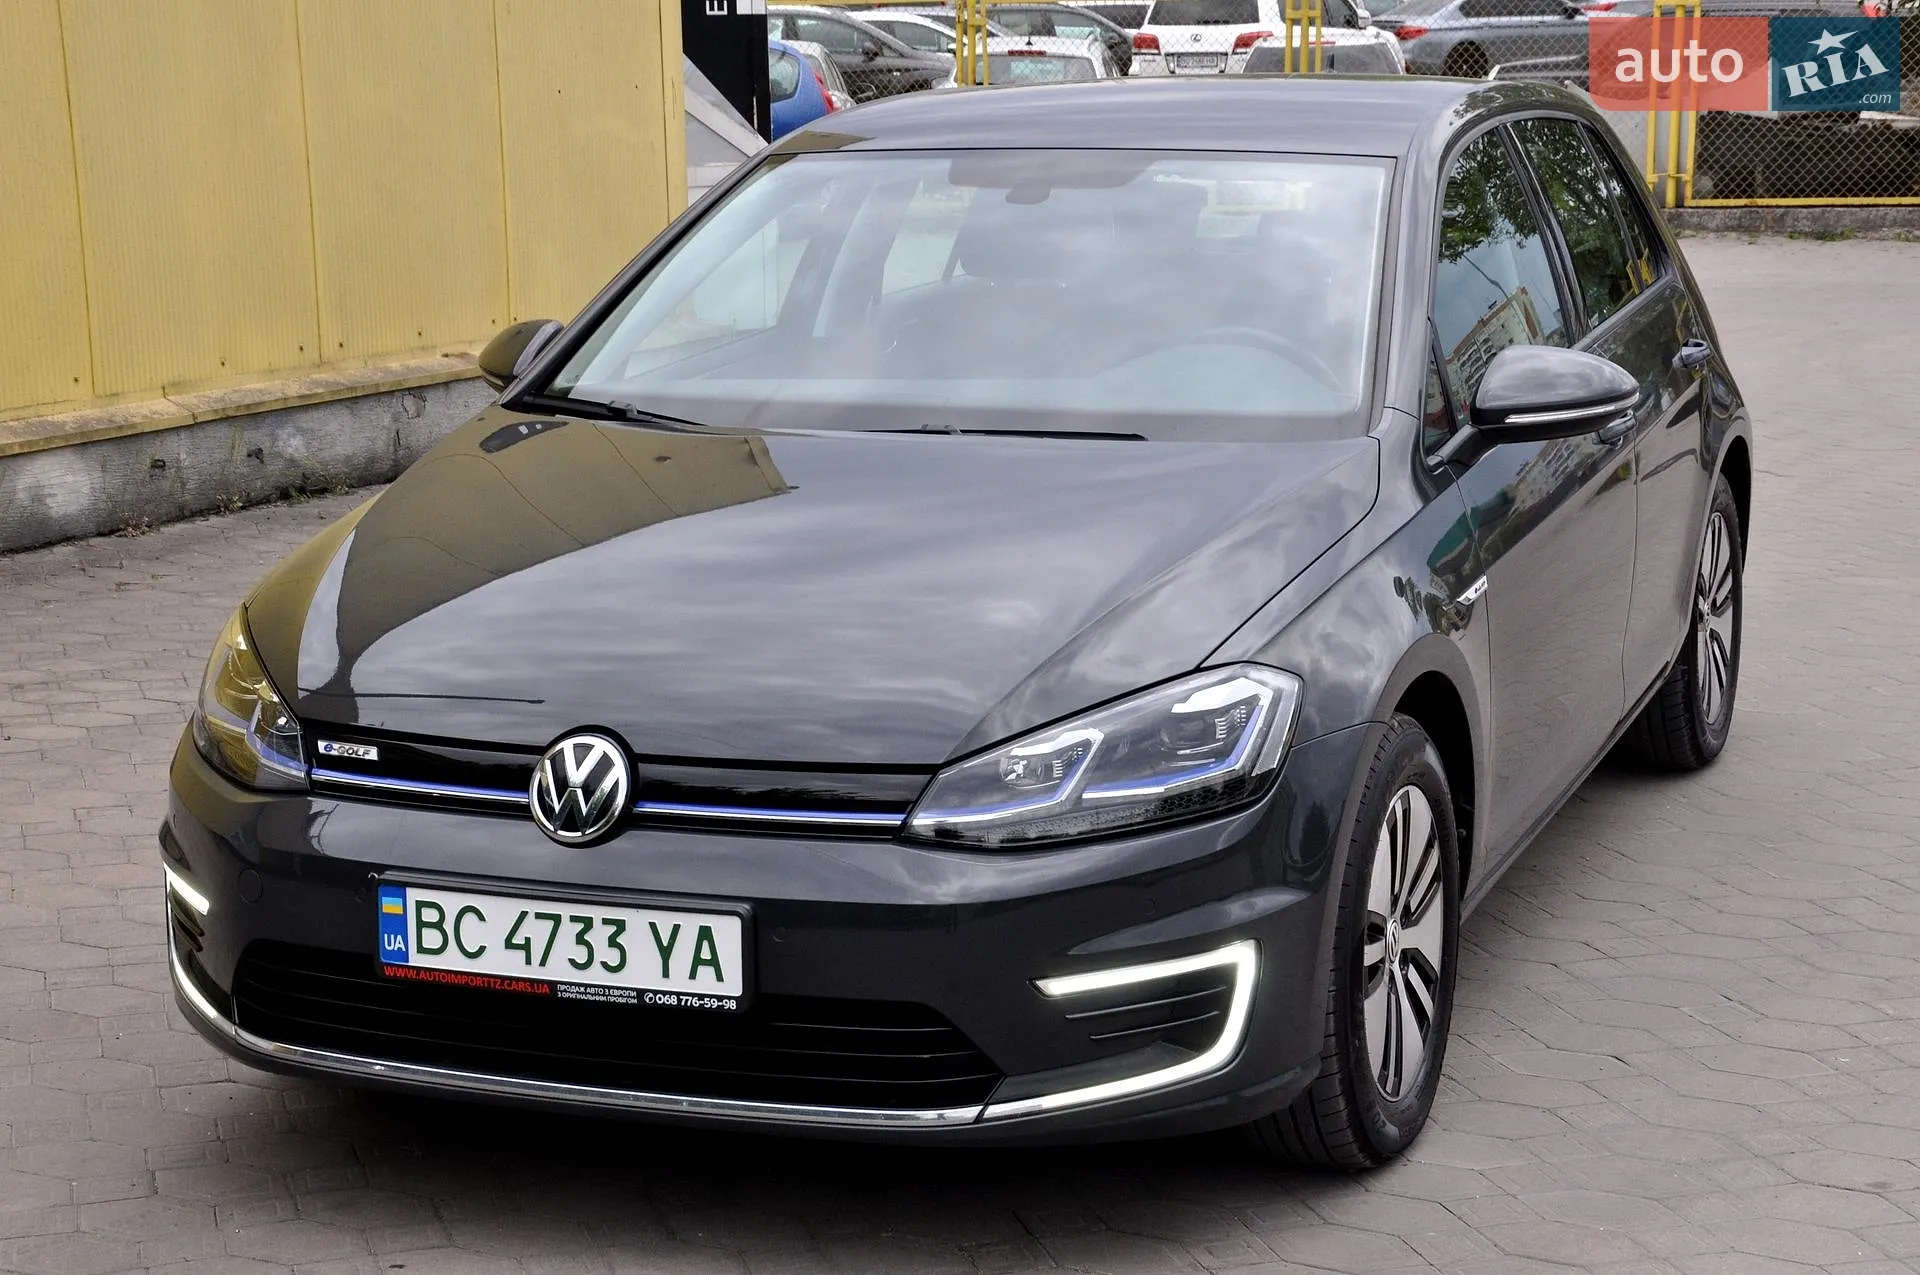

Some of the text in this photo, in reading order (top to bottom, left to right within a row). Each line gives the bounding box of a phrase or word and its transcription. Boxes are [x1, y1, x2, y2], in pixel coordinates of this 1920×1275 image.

[323, 743, 371, 758] e-GOLF
[383, 933, 406, 952] UA
[414, 899, 725, 983] BC 4733 YA
[383, 965, 551, 994] WWW.AUTOIMPORTTZ.CARS.UA
[557, 984, 586, 993] ПРОДАЖ
[586, 987, 604, 995] АВТО
[609, 989, 637, 998] ЄВРОПИ
[655, 993, 737, 1010] 068 776-59-98
